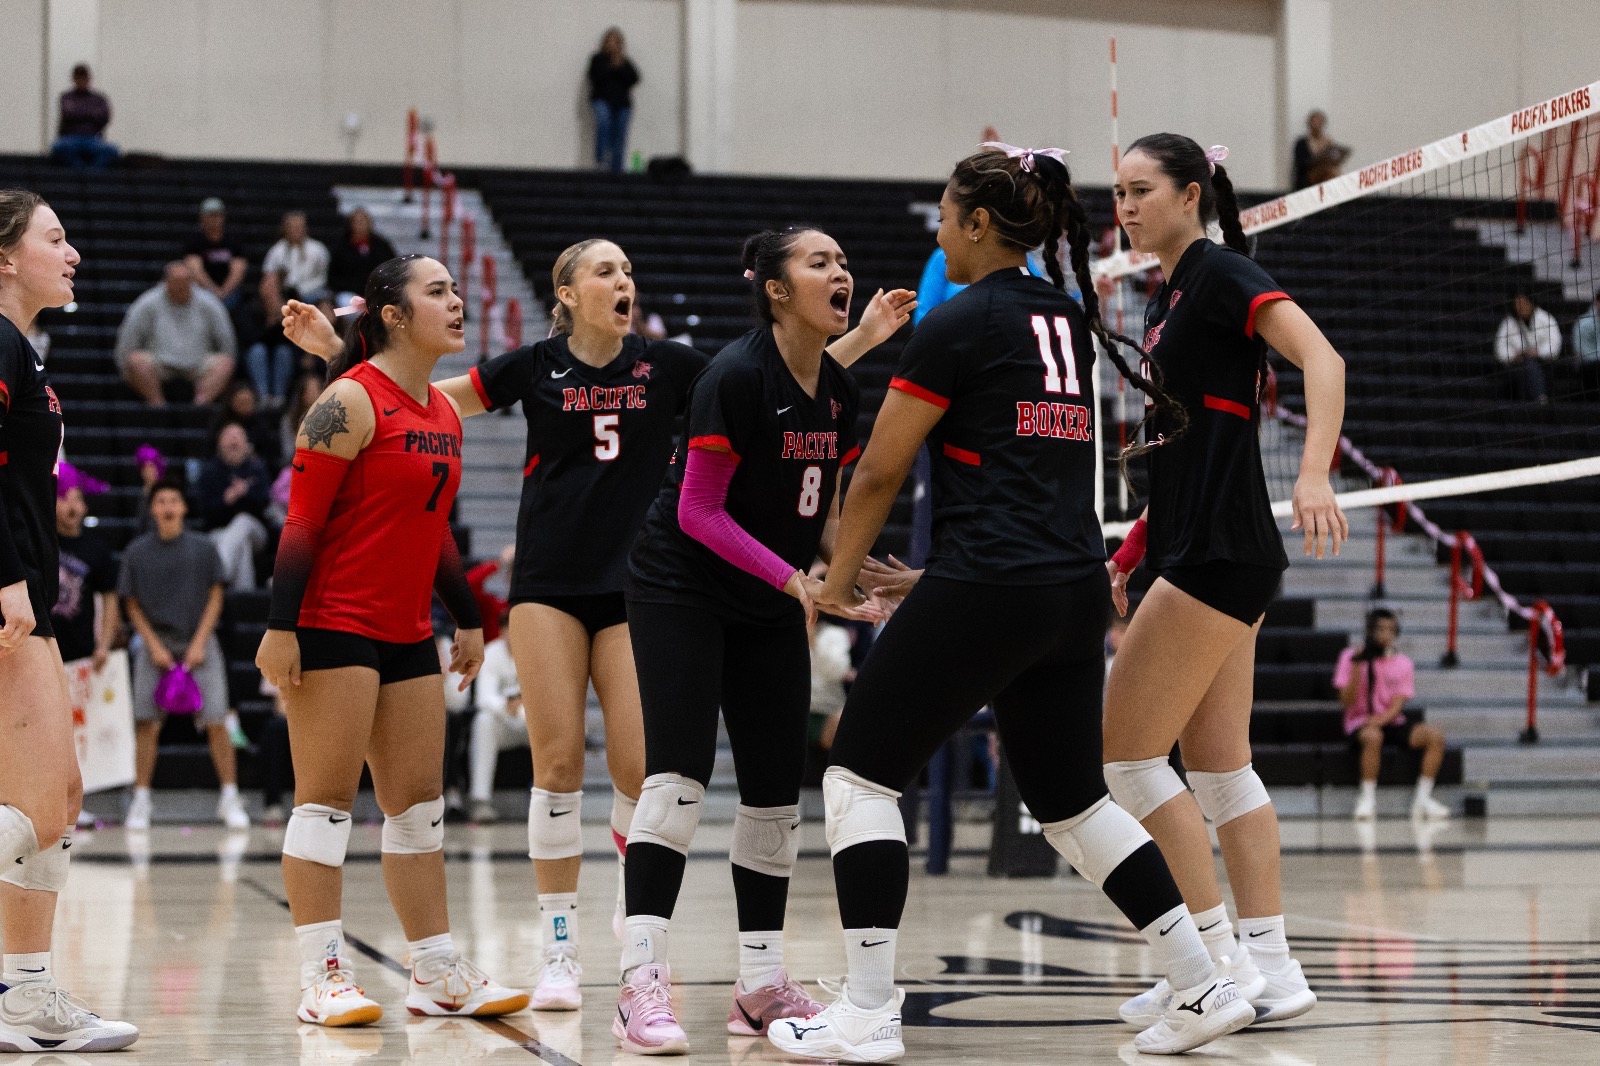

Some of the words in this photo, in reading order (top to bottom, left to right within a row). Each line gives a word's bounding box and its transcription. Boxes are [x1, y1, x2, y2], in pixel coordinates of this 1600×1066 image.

[1511, 102, 1548, 135] PACIFIC
[1551, 87, 1591, 122] BOXERS
[1359, 162, 1389, 190] PACIFIC
[1391, 149, 1423, 178] BOXERS
[1030, 314, 1081, 396] 11
[562, 385, 647, 411] PACIFIC
[1016, 401, 1093, 441] BOXER
[592, 413, 620, 462] 5
[425, 461, 450, 512] 7
[797, 464, 822, 518] 8
